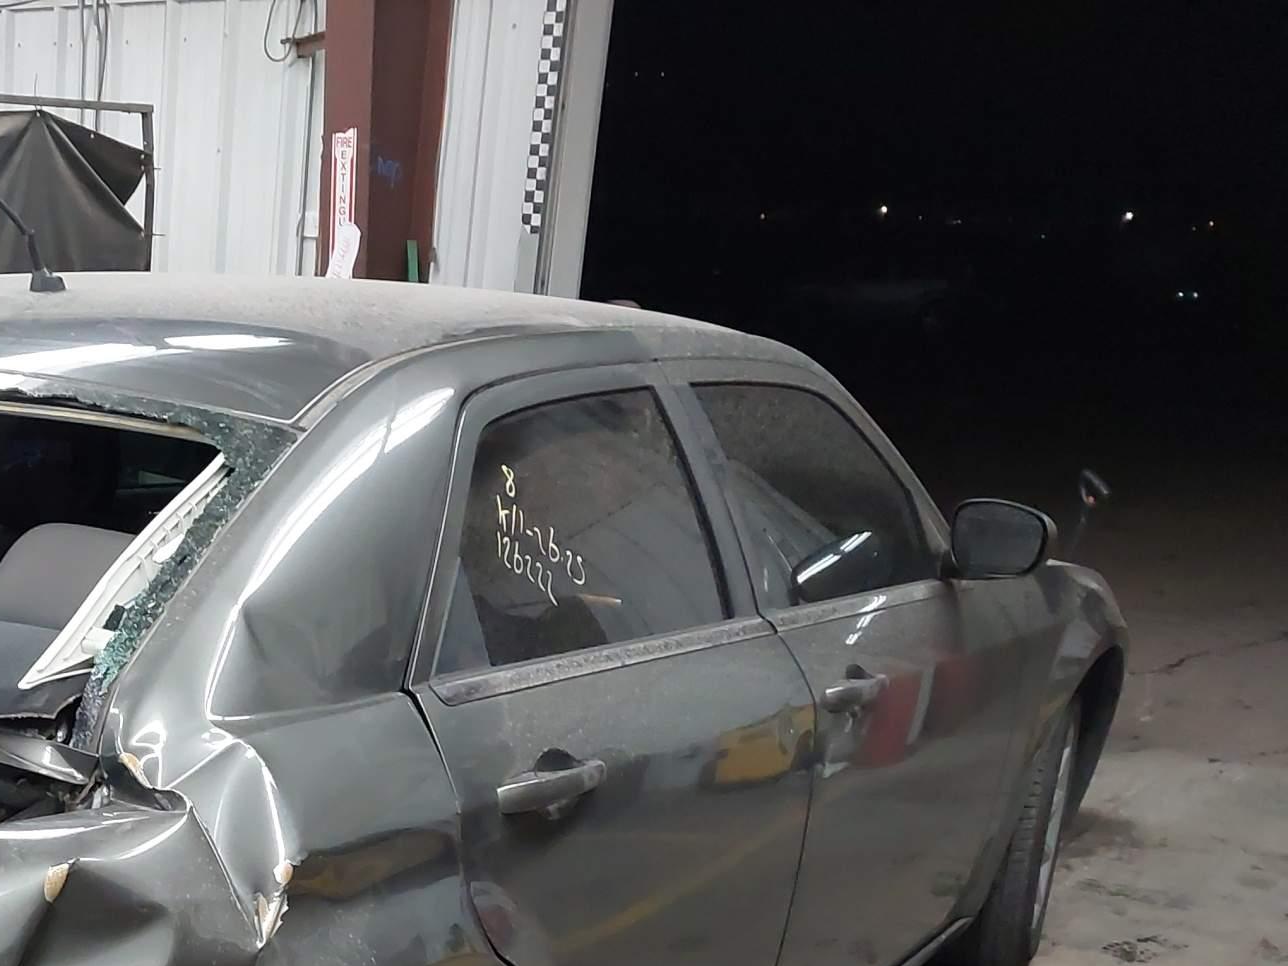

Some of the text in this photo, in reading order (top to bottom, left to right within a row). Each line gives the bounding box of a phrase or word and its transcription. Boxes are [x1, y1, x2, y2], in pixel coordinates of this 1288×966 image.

[336, 136, 353, 149] FIRE
[501, 464, 515, 497] 8
[497, 531, 559, 606] 126222
